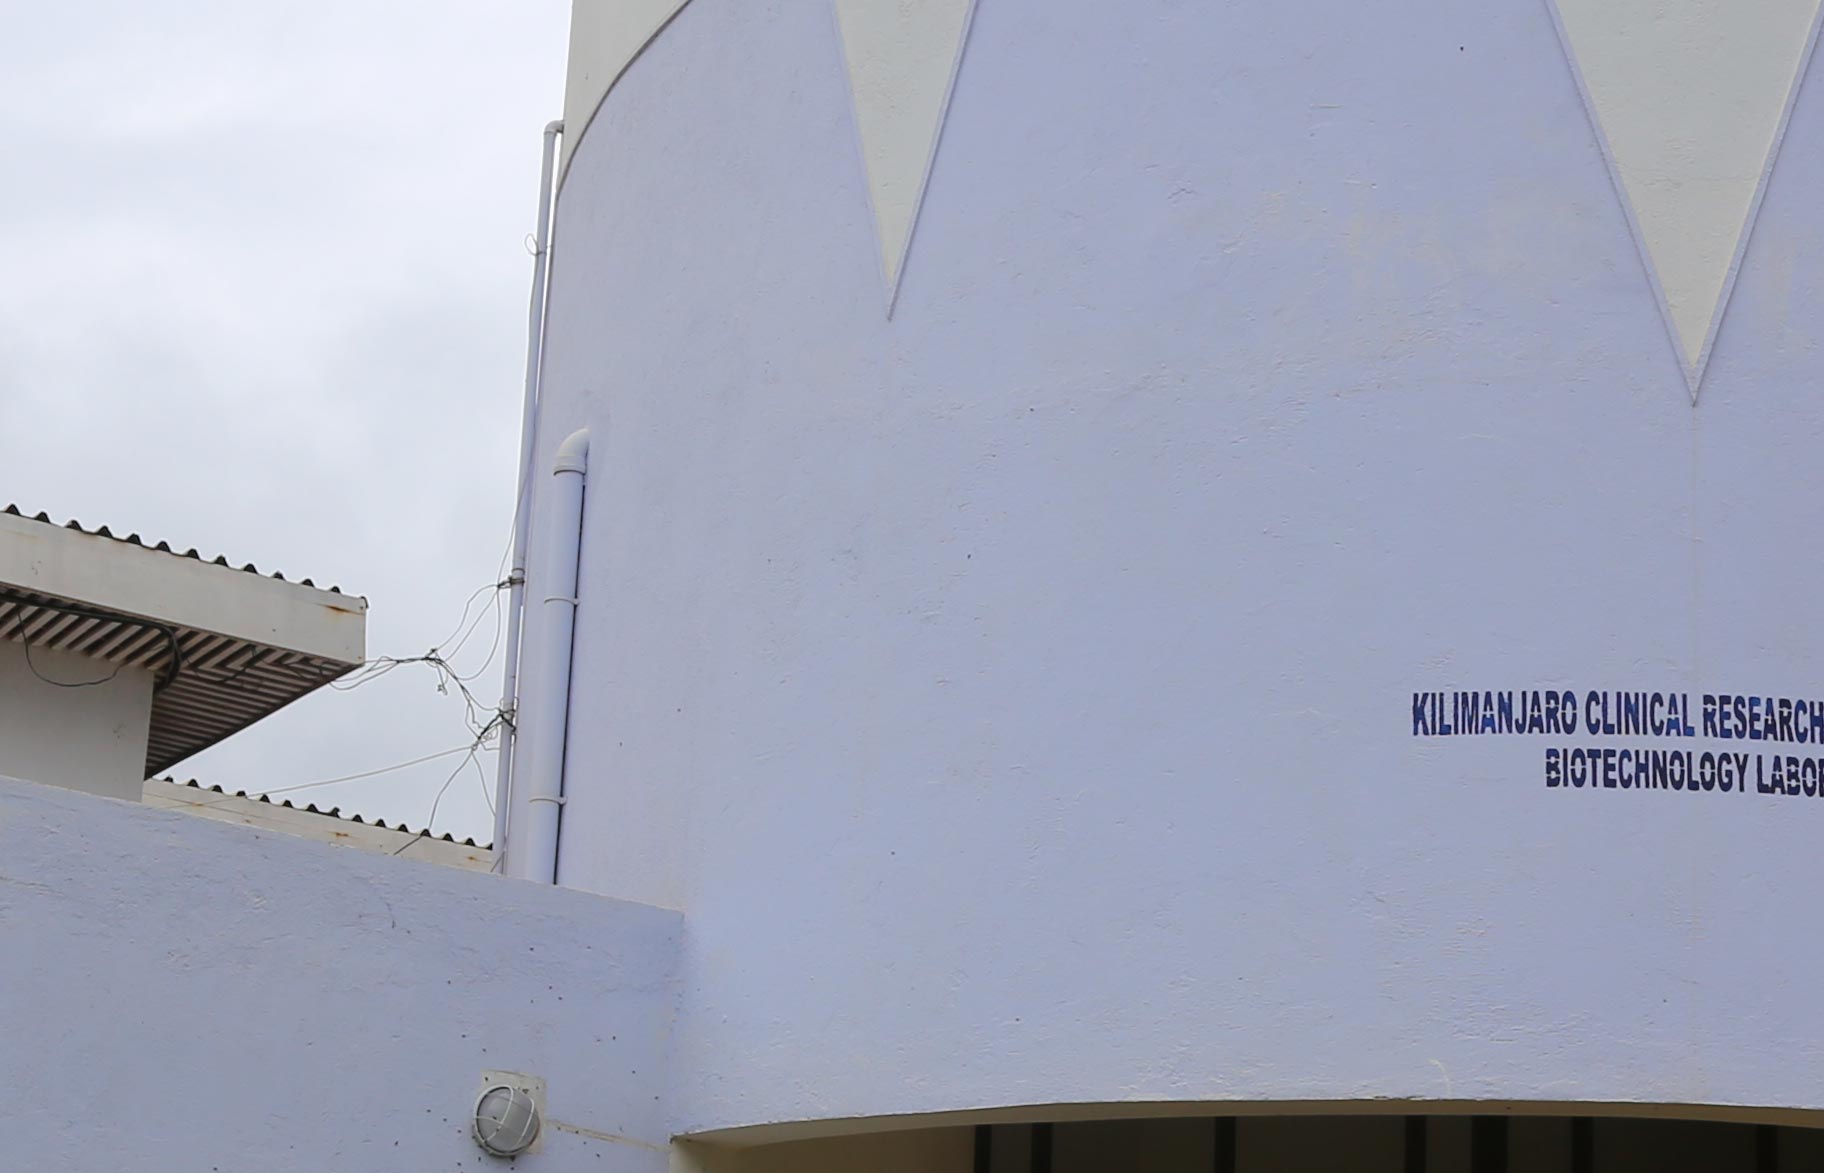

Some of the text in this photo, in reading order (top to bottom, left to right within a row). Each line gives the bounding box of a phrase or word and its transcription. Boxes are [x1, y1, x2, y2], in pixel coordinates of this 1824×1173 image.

[1412, 690, 1578, 737] KILIMANJARO
[1585, 690, 1696, 738] CLINICAL
[1545, 748, 1749, 793] BIOTECHNOLOGY
